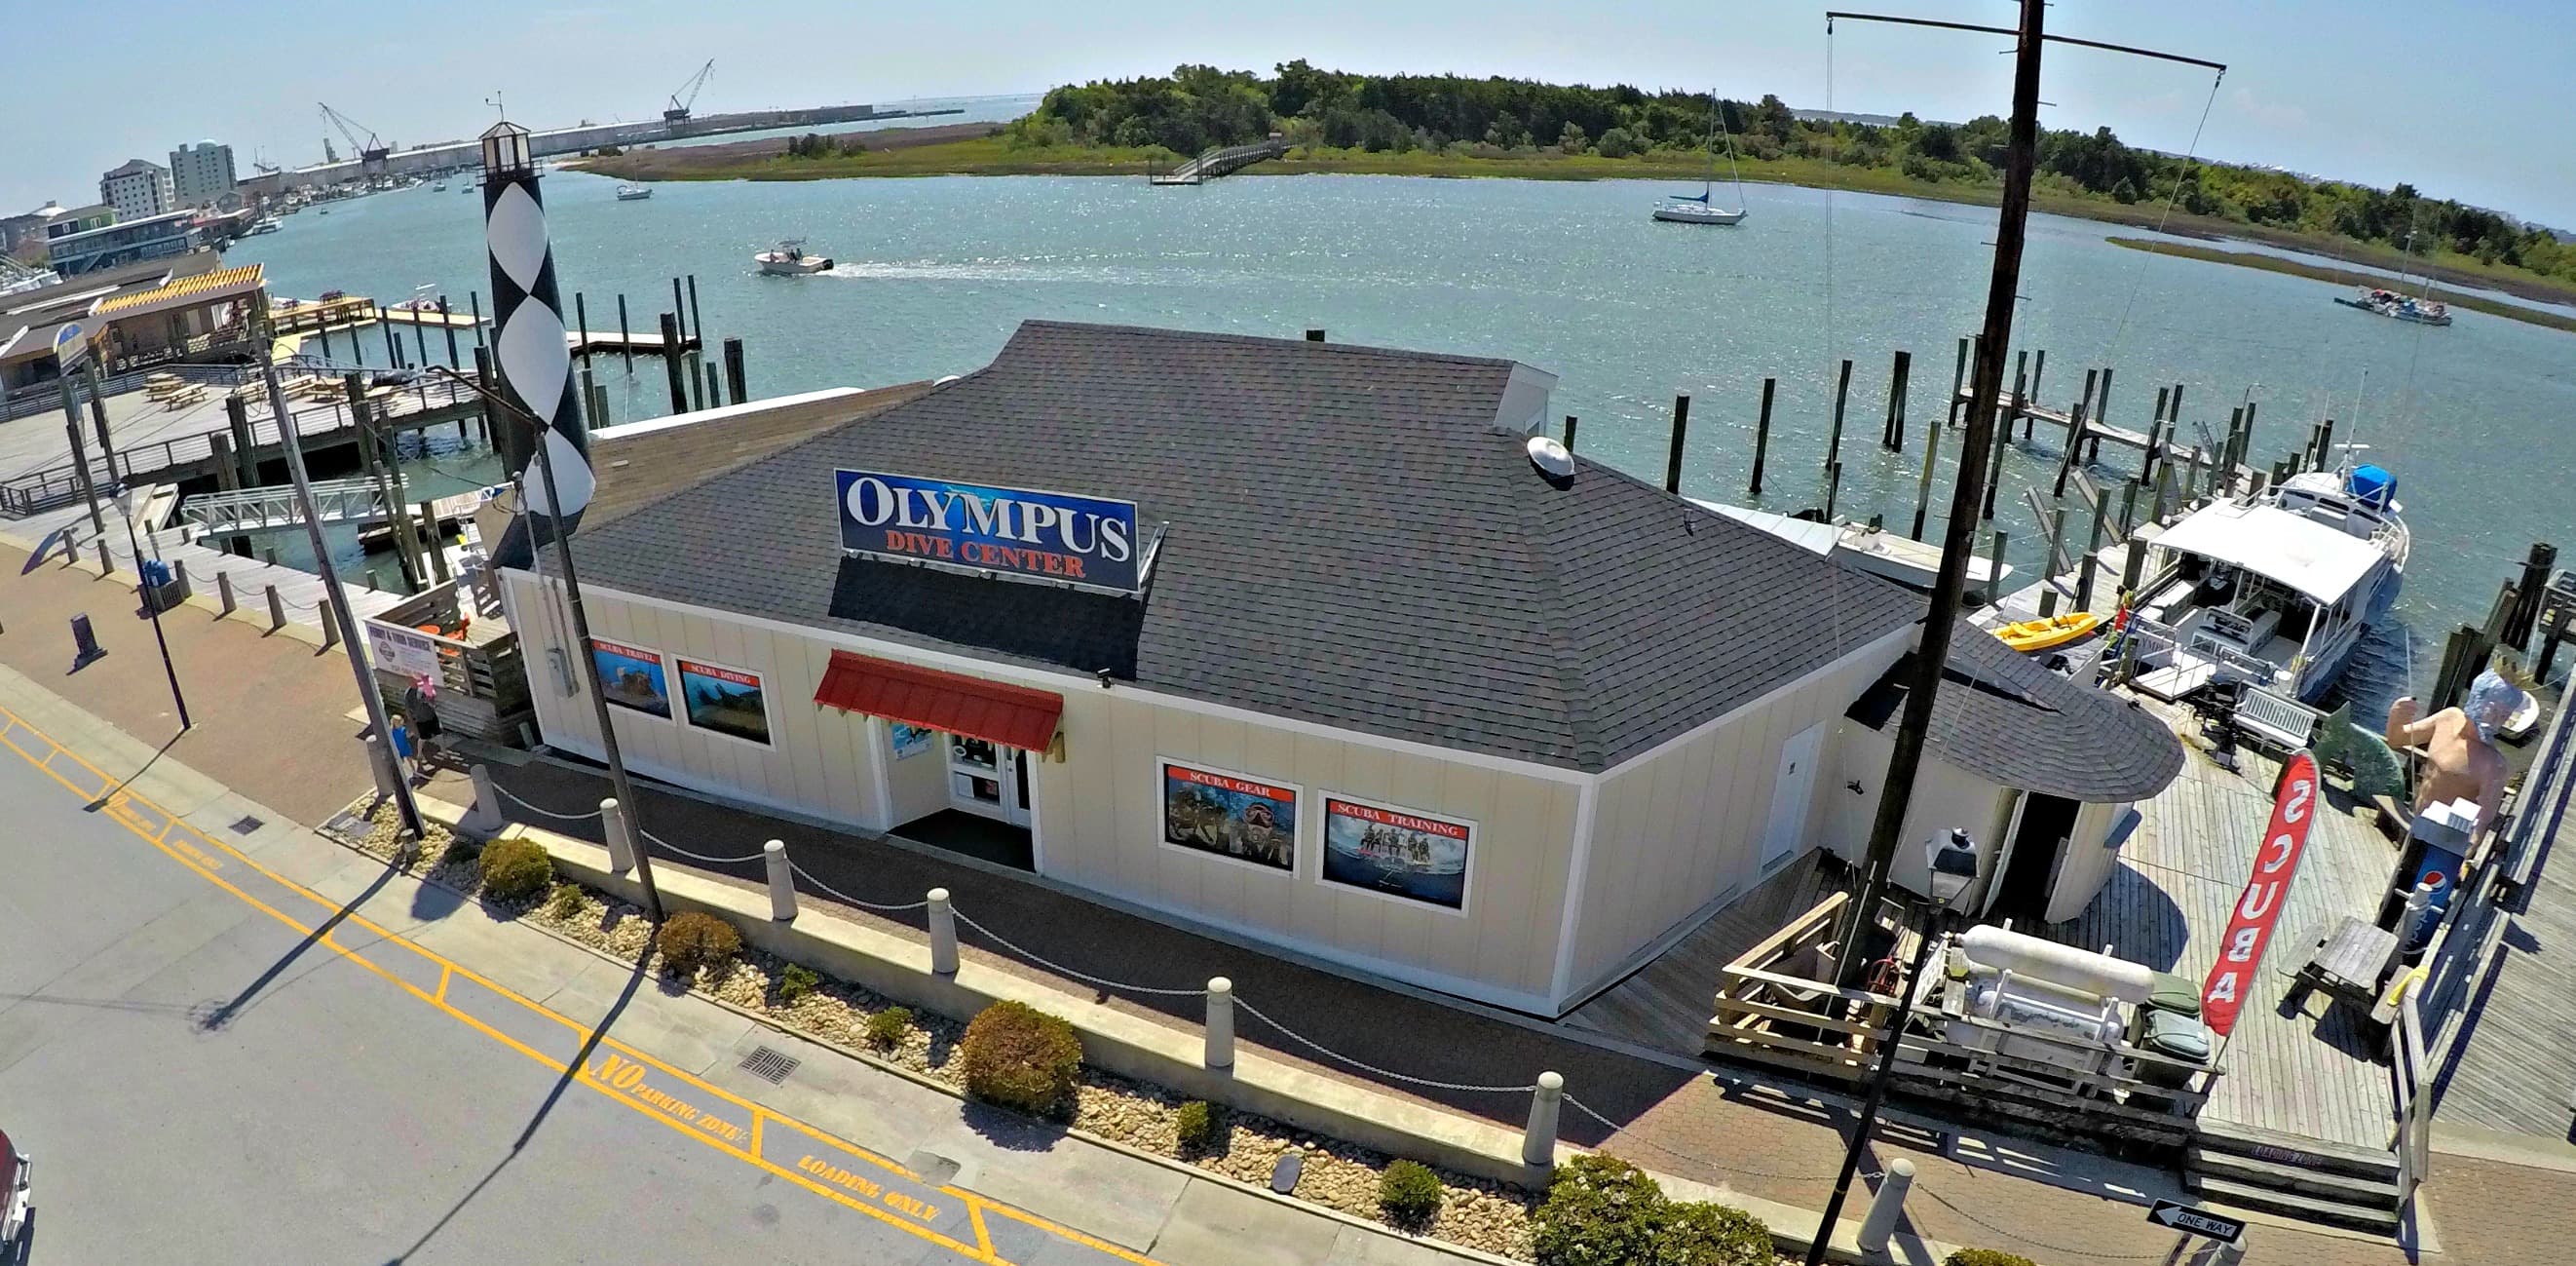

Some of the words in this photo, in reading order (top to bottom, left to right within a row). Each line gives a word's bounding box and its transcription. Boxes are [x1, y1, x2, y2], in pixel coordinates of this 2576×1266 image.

[847, 477, 1130, 563] OLYMPUS
[886, 530, 954, 560] DIVE
[962, 541, 1086, 579] CENTER
[598, 642, 624, 655] SCUBA
[691, 665, 717, 678] SCUBA
[721, 671, 750, 684] DIVING
[1190, 772, 1231, 788] SCUBA
[1235, 782, 1271, 797] GEAR
[1338, 803, 1381, 821] SCUBA
[1388, 815, 1458, 836] TRAINING
[590, 1054, 647, 1089] NO
[631, 1083, 701, 1121] PARKING
[697, 1114, 749, 1143] ZONE
[797, 1155, 884, 1199] LOADING
[883, 1191, 941, 1223] ONLY
[2178, 1213, 2204, 1228] ONE
[2206, 1220, 2233, 1234] WAY
